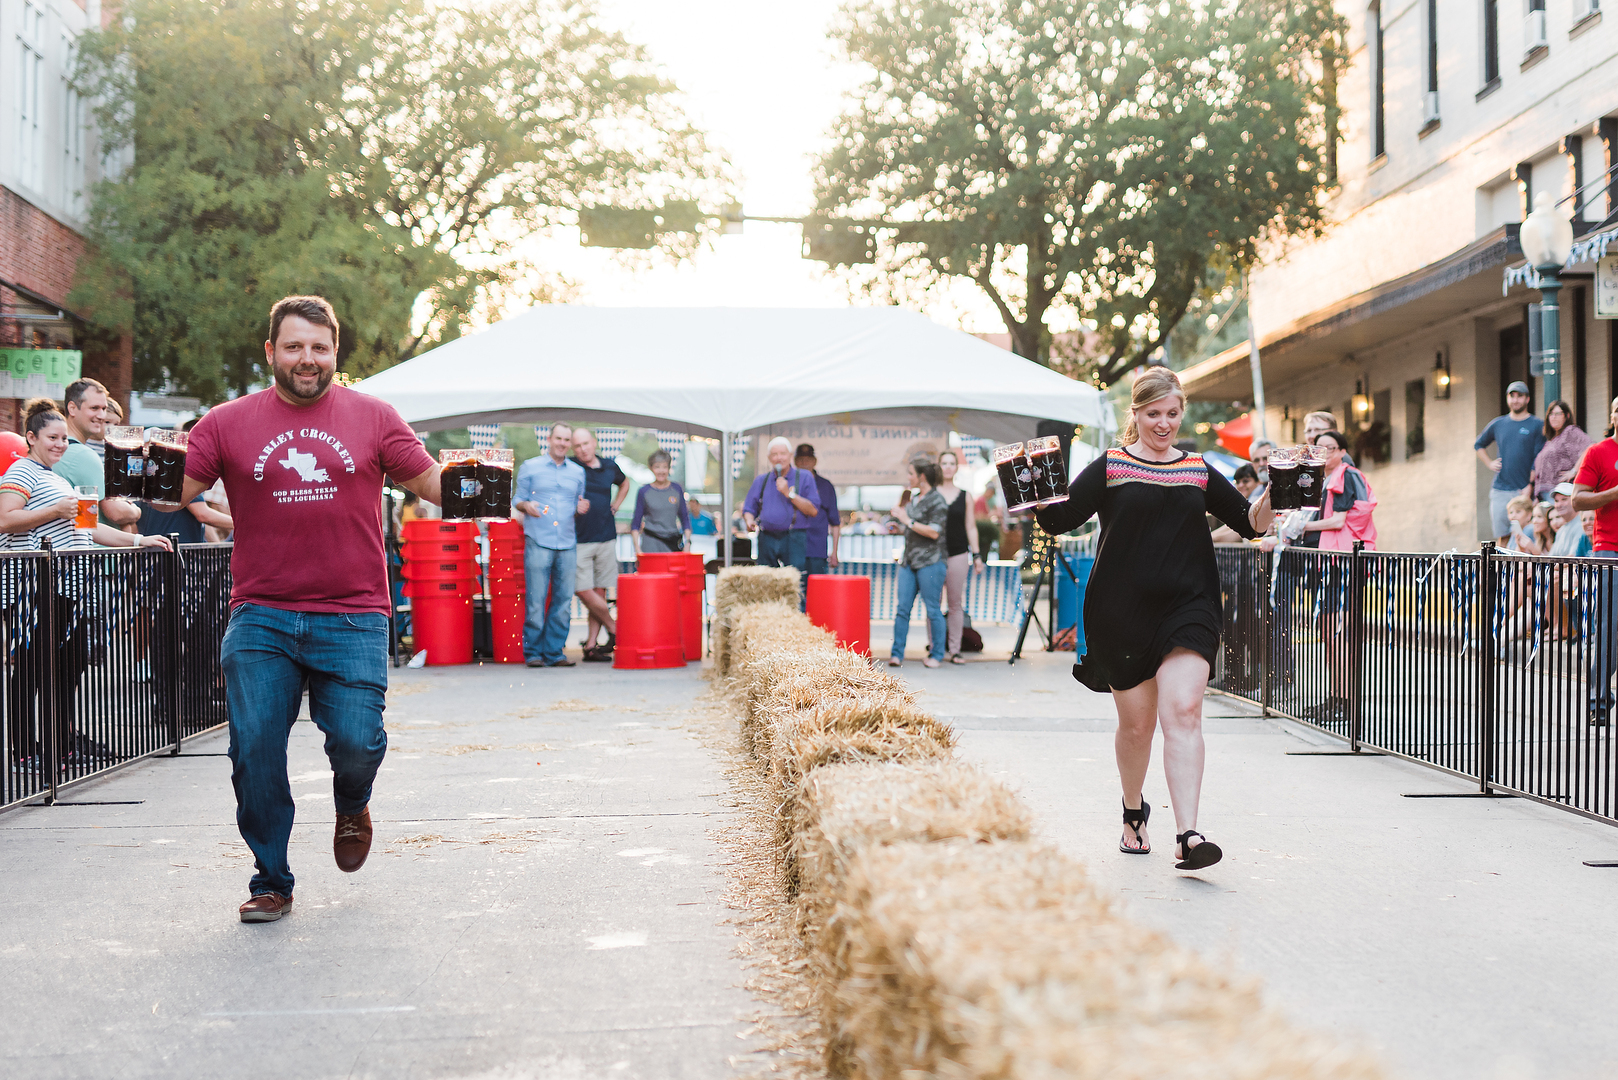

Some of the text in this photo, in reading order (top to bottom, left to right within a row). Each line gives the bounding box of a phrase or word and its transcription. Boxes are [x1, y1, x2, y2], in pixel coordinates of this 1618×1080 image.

[0, 353, 76, 378] acets
[253, 428, 356, 481] CHARLEY CROCKETT
[290, 488, 313, 496] BLESS
[314, 486, 338, 494] TEXAS
[295, 493, 334, 503] LOUISIANA
